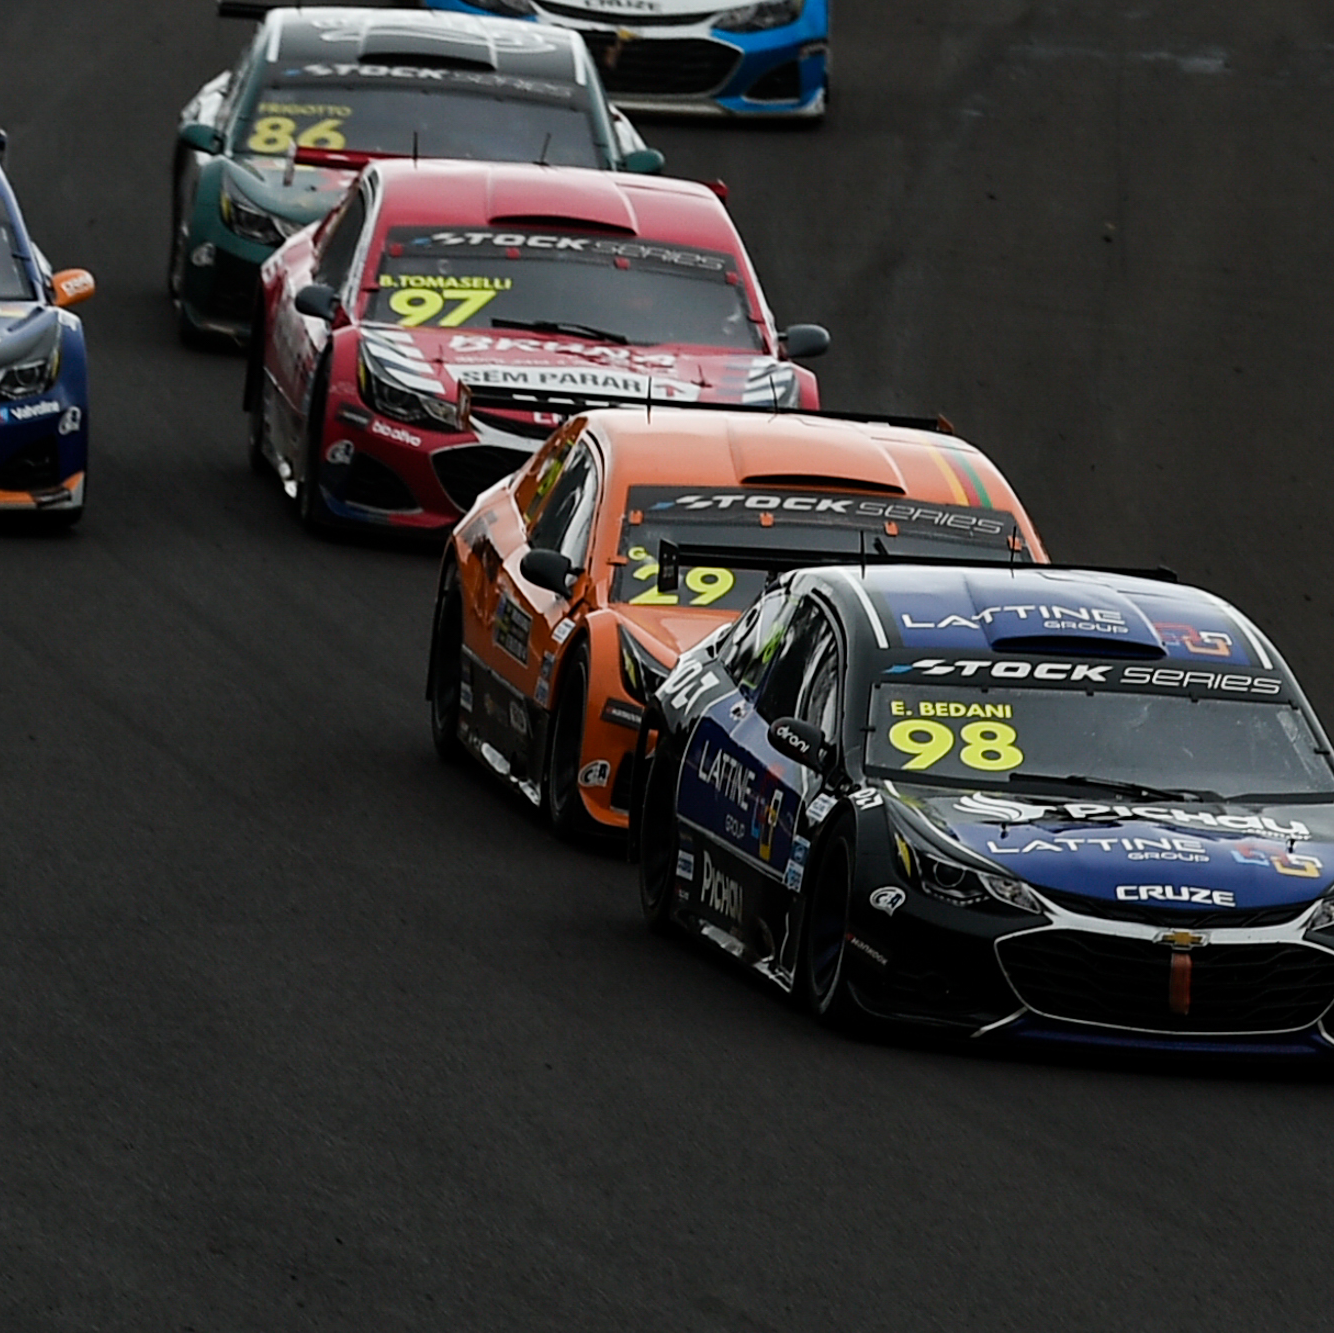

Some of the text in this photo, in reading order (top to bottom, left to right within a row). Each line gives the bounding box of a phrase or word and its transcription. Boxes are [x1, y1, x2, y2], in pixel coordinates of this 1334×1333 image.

[248, 116, 346, 154] 86
[431, 232, 591, 251] STOCK
[389, 288, 497, 327] 97
[461, 369, 643, 394] SEM PARAR
[675, 494, 1005, 535] STOCK SERIES
[628, 566, 735, 606] 29
[902, 605, 1127, 630] LATTINE
[1043, 620, 1130, 634] GROUP
[911, 658, 1283, 696] STOCK SERIES
[890, 700, 1012, 719] E. BEDANI
[888, 719, 1024, 772] 98
[986, 837, 1206, 855] LATTINE
[1127, 851, 1210, 863] GROUP
[1115, 884, 1237, 907] CRUZE
